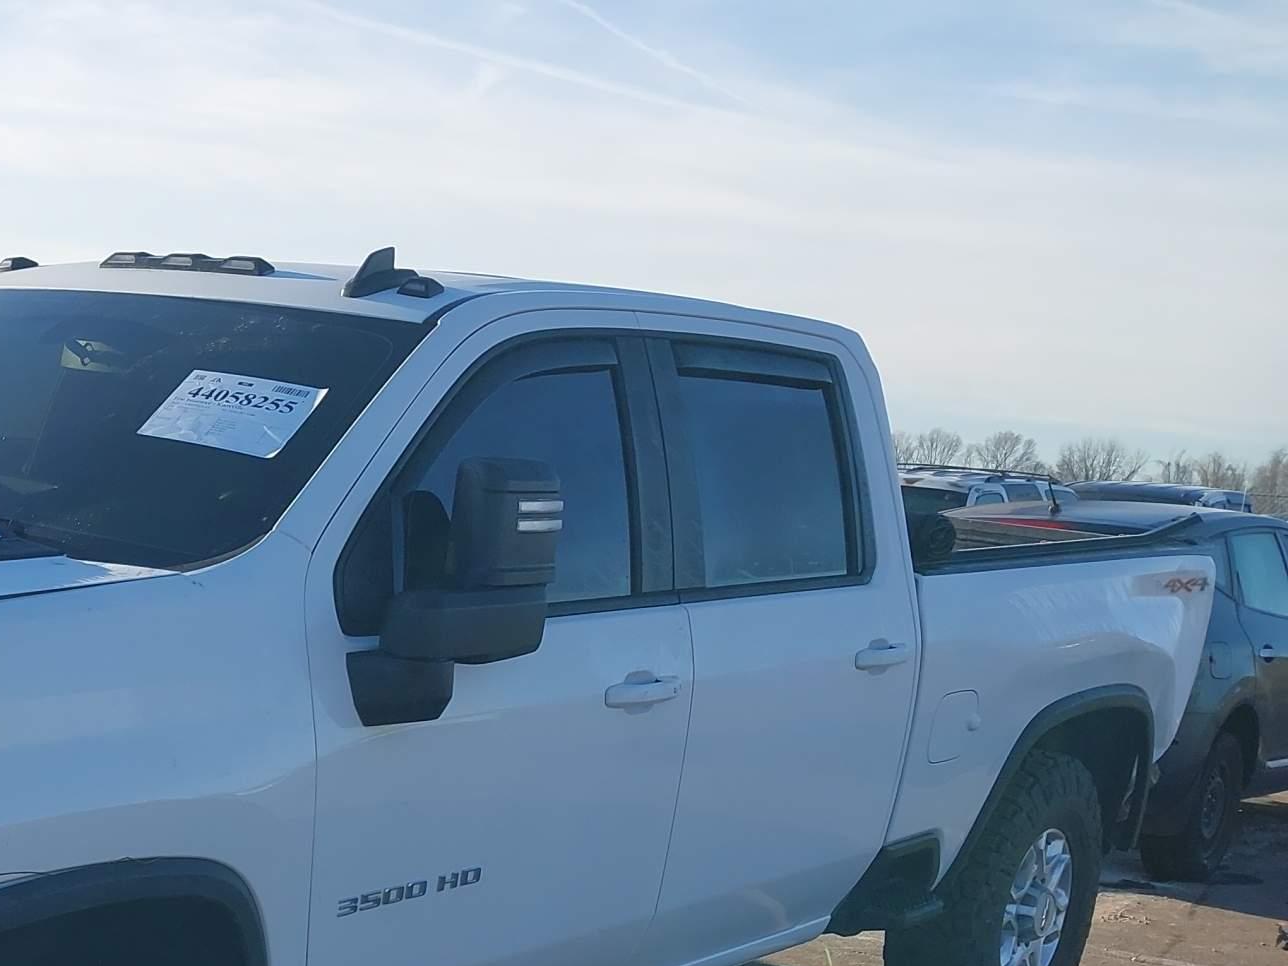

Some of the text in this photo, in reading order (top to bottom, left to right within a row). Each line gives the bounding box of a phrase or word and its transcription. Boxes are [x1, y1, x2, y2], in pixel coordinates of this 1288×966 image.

[187, 385, 298, 415] 44058255
[336, 867, 482, 918] 3500 HD
